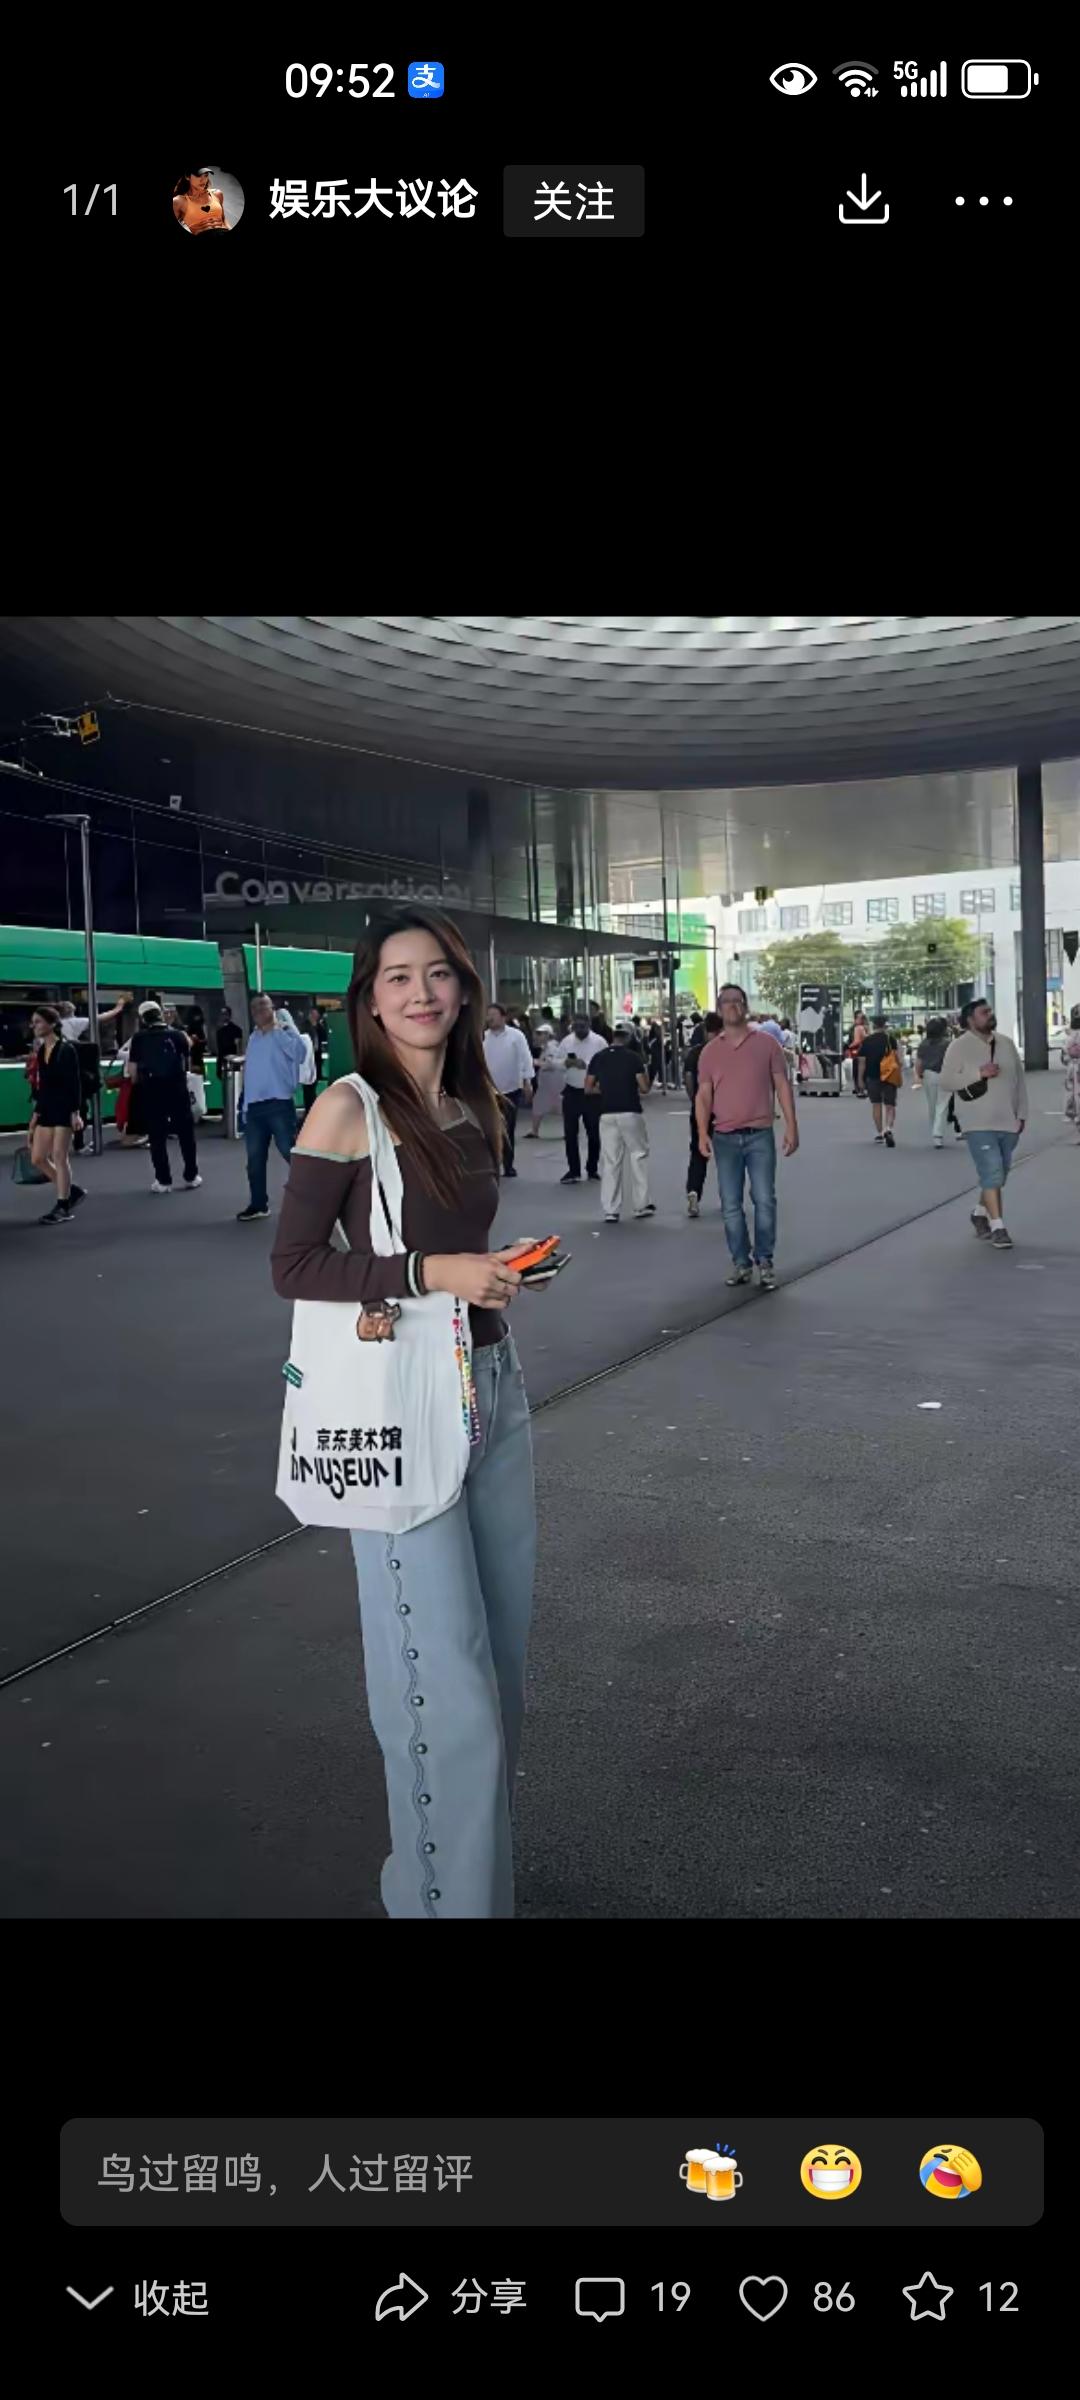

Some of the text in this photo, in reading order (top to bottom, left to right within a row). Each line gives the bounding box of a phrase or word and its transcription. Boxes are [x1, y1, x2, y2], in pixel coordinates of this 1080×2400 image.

[214, 871, 471, 904] Conversation
[317, 1426, 402, 1451] 京东美术馆
